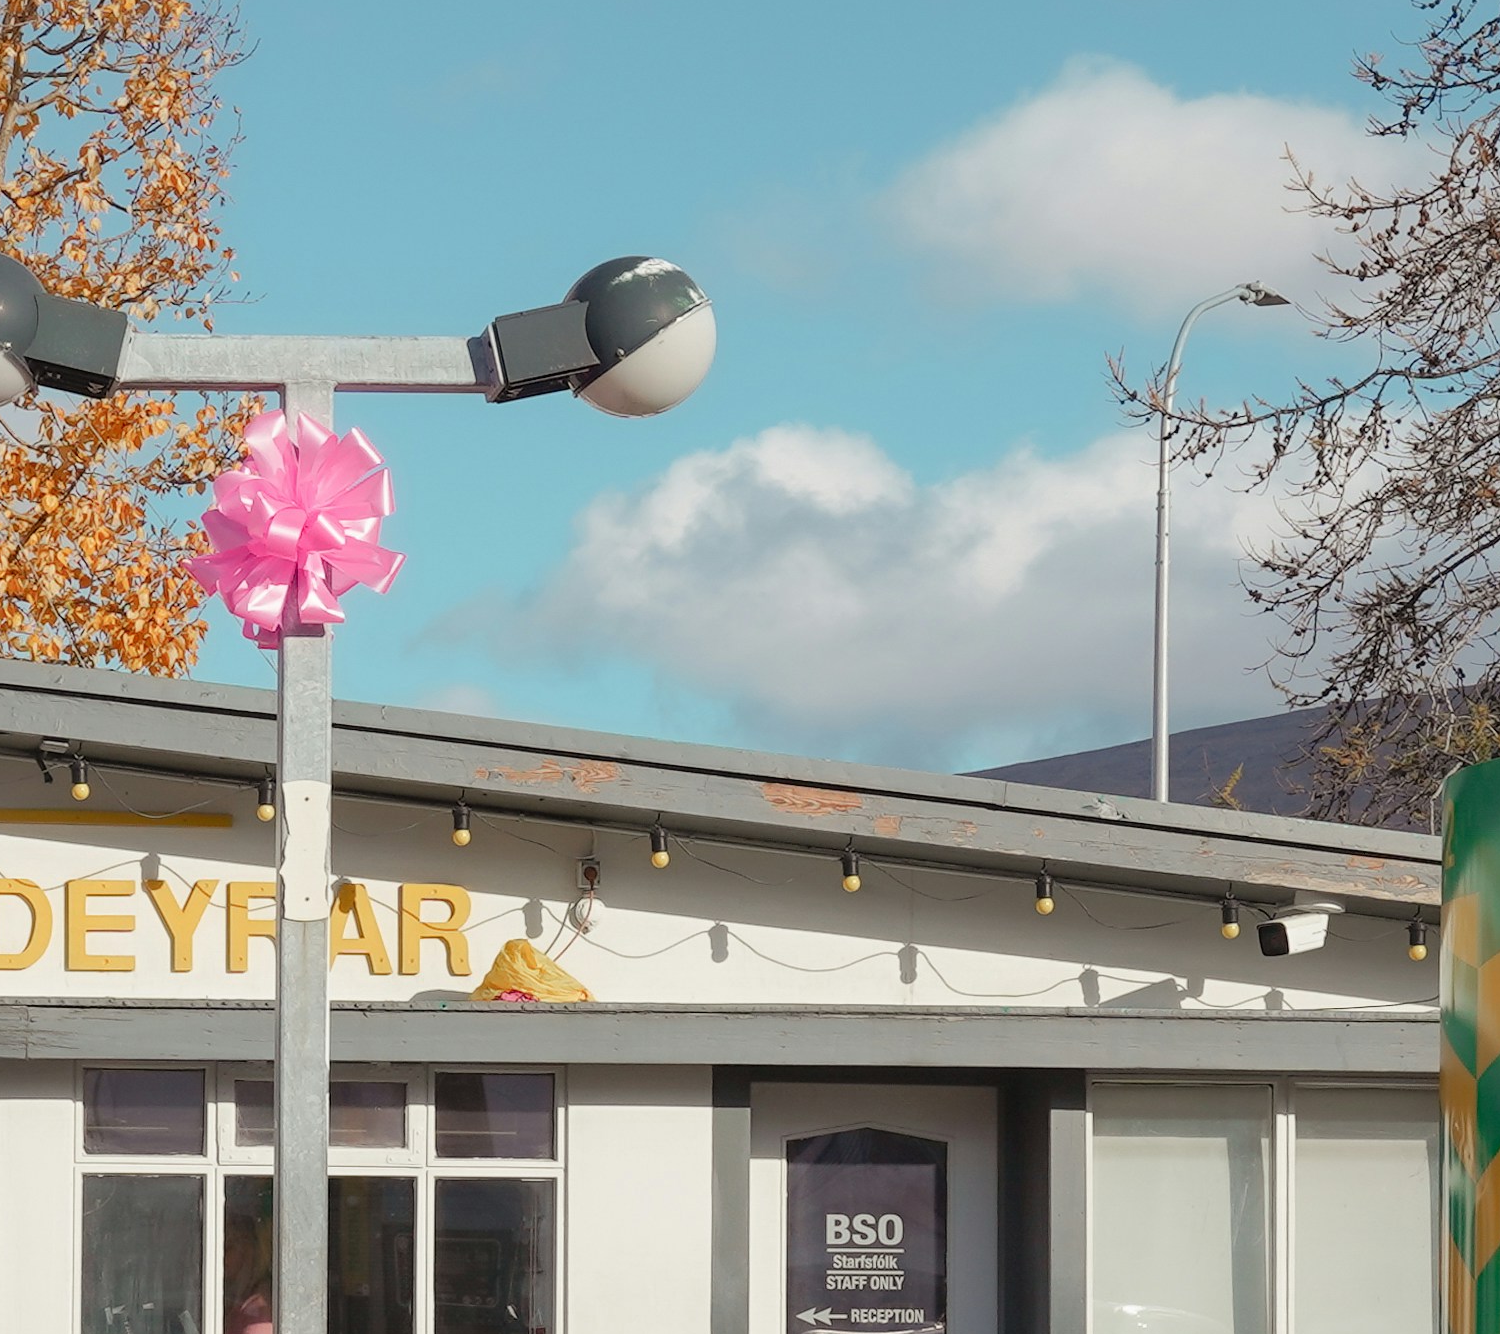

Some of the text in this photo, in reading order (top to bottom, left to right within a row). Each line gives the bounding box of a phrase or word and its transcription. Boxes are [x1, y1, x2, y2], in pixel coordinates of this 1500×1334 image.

[826, 1214, 904, 1246] BSO
[833, 1254, 898, 1270] Starfsfólk
[826, 1275, 904, 1291] STAFF ONLY
[851, 1308, 925, 1325] RECEPTION
